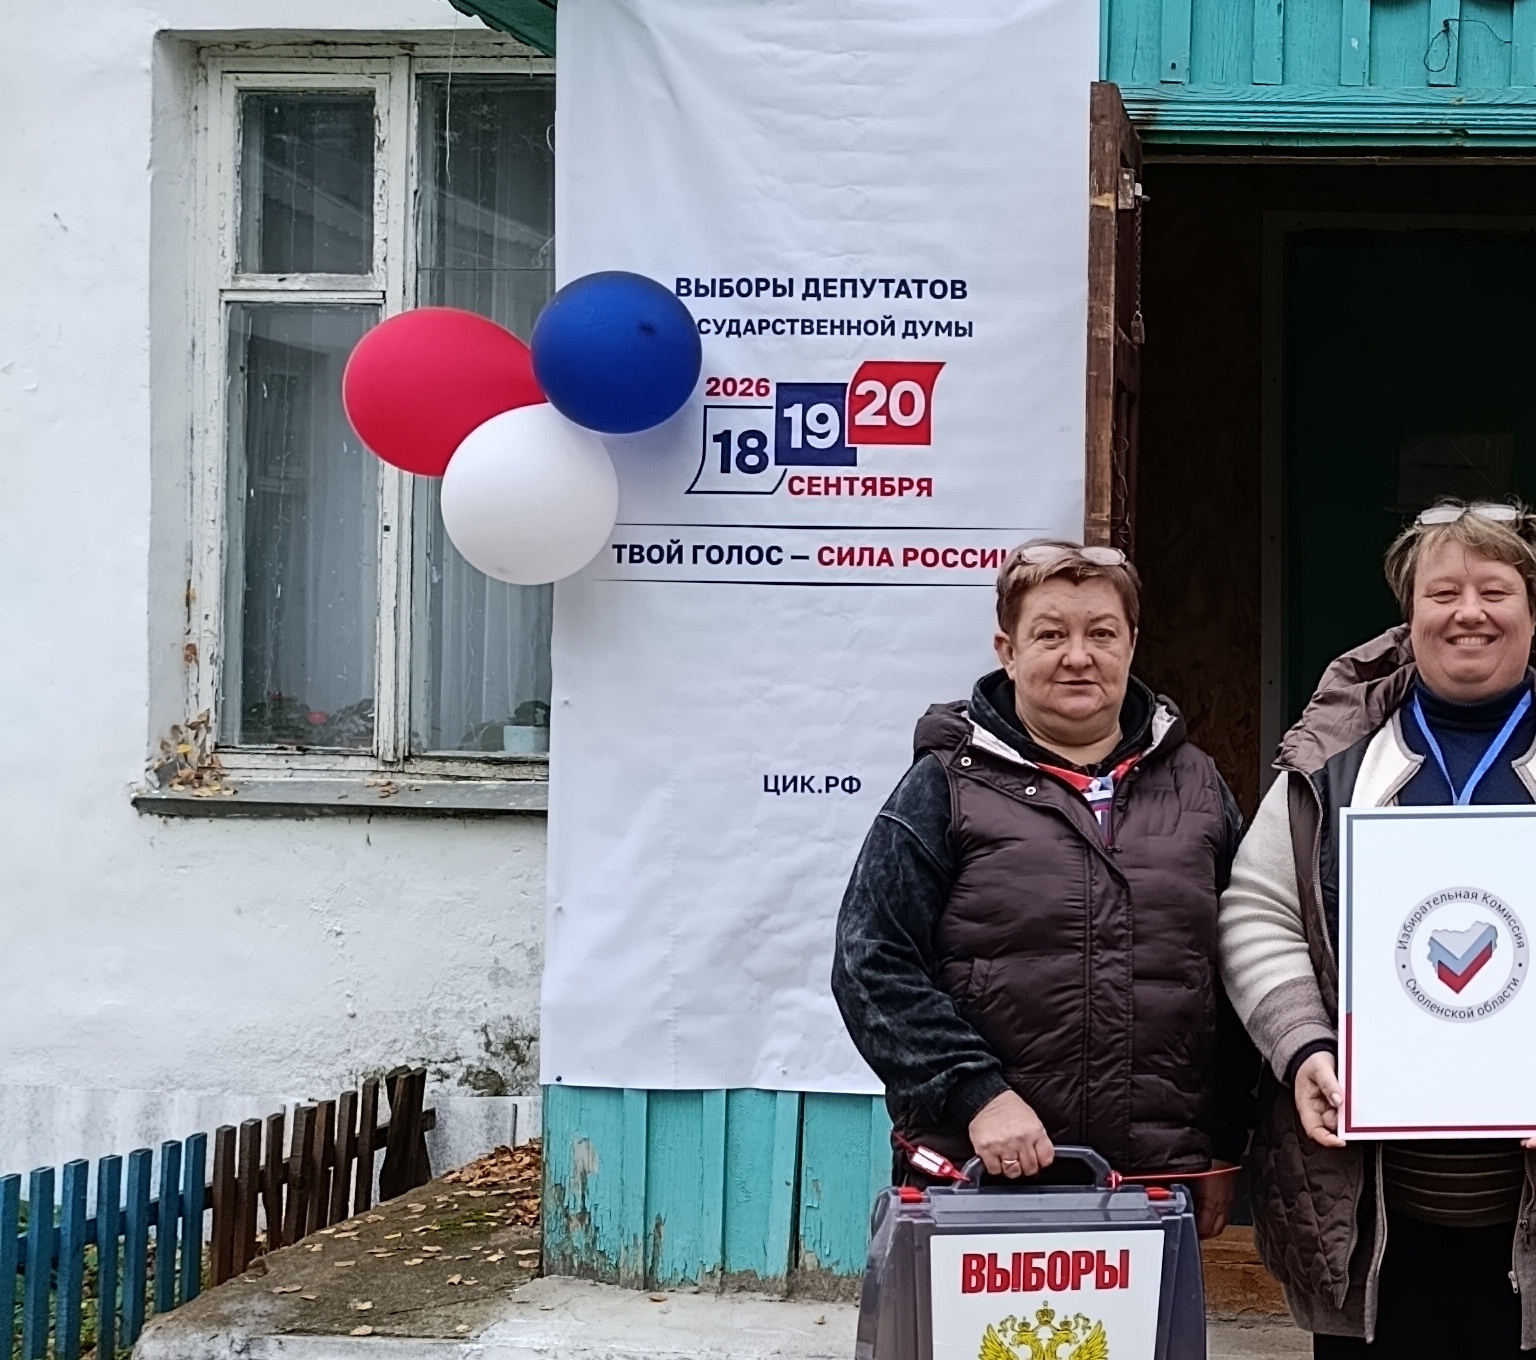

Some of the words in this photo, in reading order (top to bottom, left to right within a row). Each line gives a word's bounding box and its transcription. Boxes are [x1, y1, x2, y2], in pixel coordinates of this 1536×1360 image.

[675, 277, 794, 299] ВЫБОРЫ
[801, 278, 968, 302] ДЕПУТАТОВ
[697, 315, 896, 339] СУДАРСТВЕННОЙ
[901, 320, 973, 339] ДУМЫ
[705, 377, 771, 398] 2026
[854, 380, 926, 427] 20
[783, 402, 840, 449] 19
[712, 429, 769, 475] 18
[787, 475, 933, 497] СЕНТЯБРЯ
[611, 538, 684, 565] ТВОЙ
[692, 544, 783, 566] ГОЛОС
[817, 546, 894, 567] СИЛА
[762, 774, 862, 796] ЦИК.РФ
[1397, 890, 1479, 950] Избирательная
[1481, 892, 1525, 949] Комиссия
[1405, 978, 1475, 1019] Смоленской
[1477, 977, 1520, 1017] области
[961, 1248, 1130, 1294] ВЫБОРЫ
